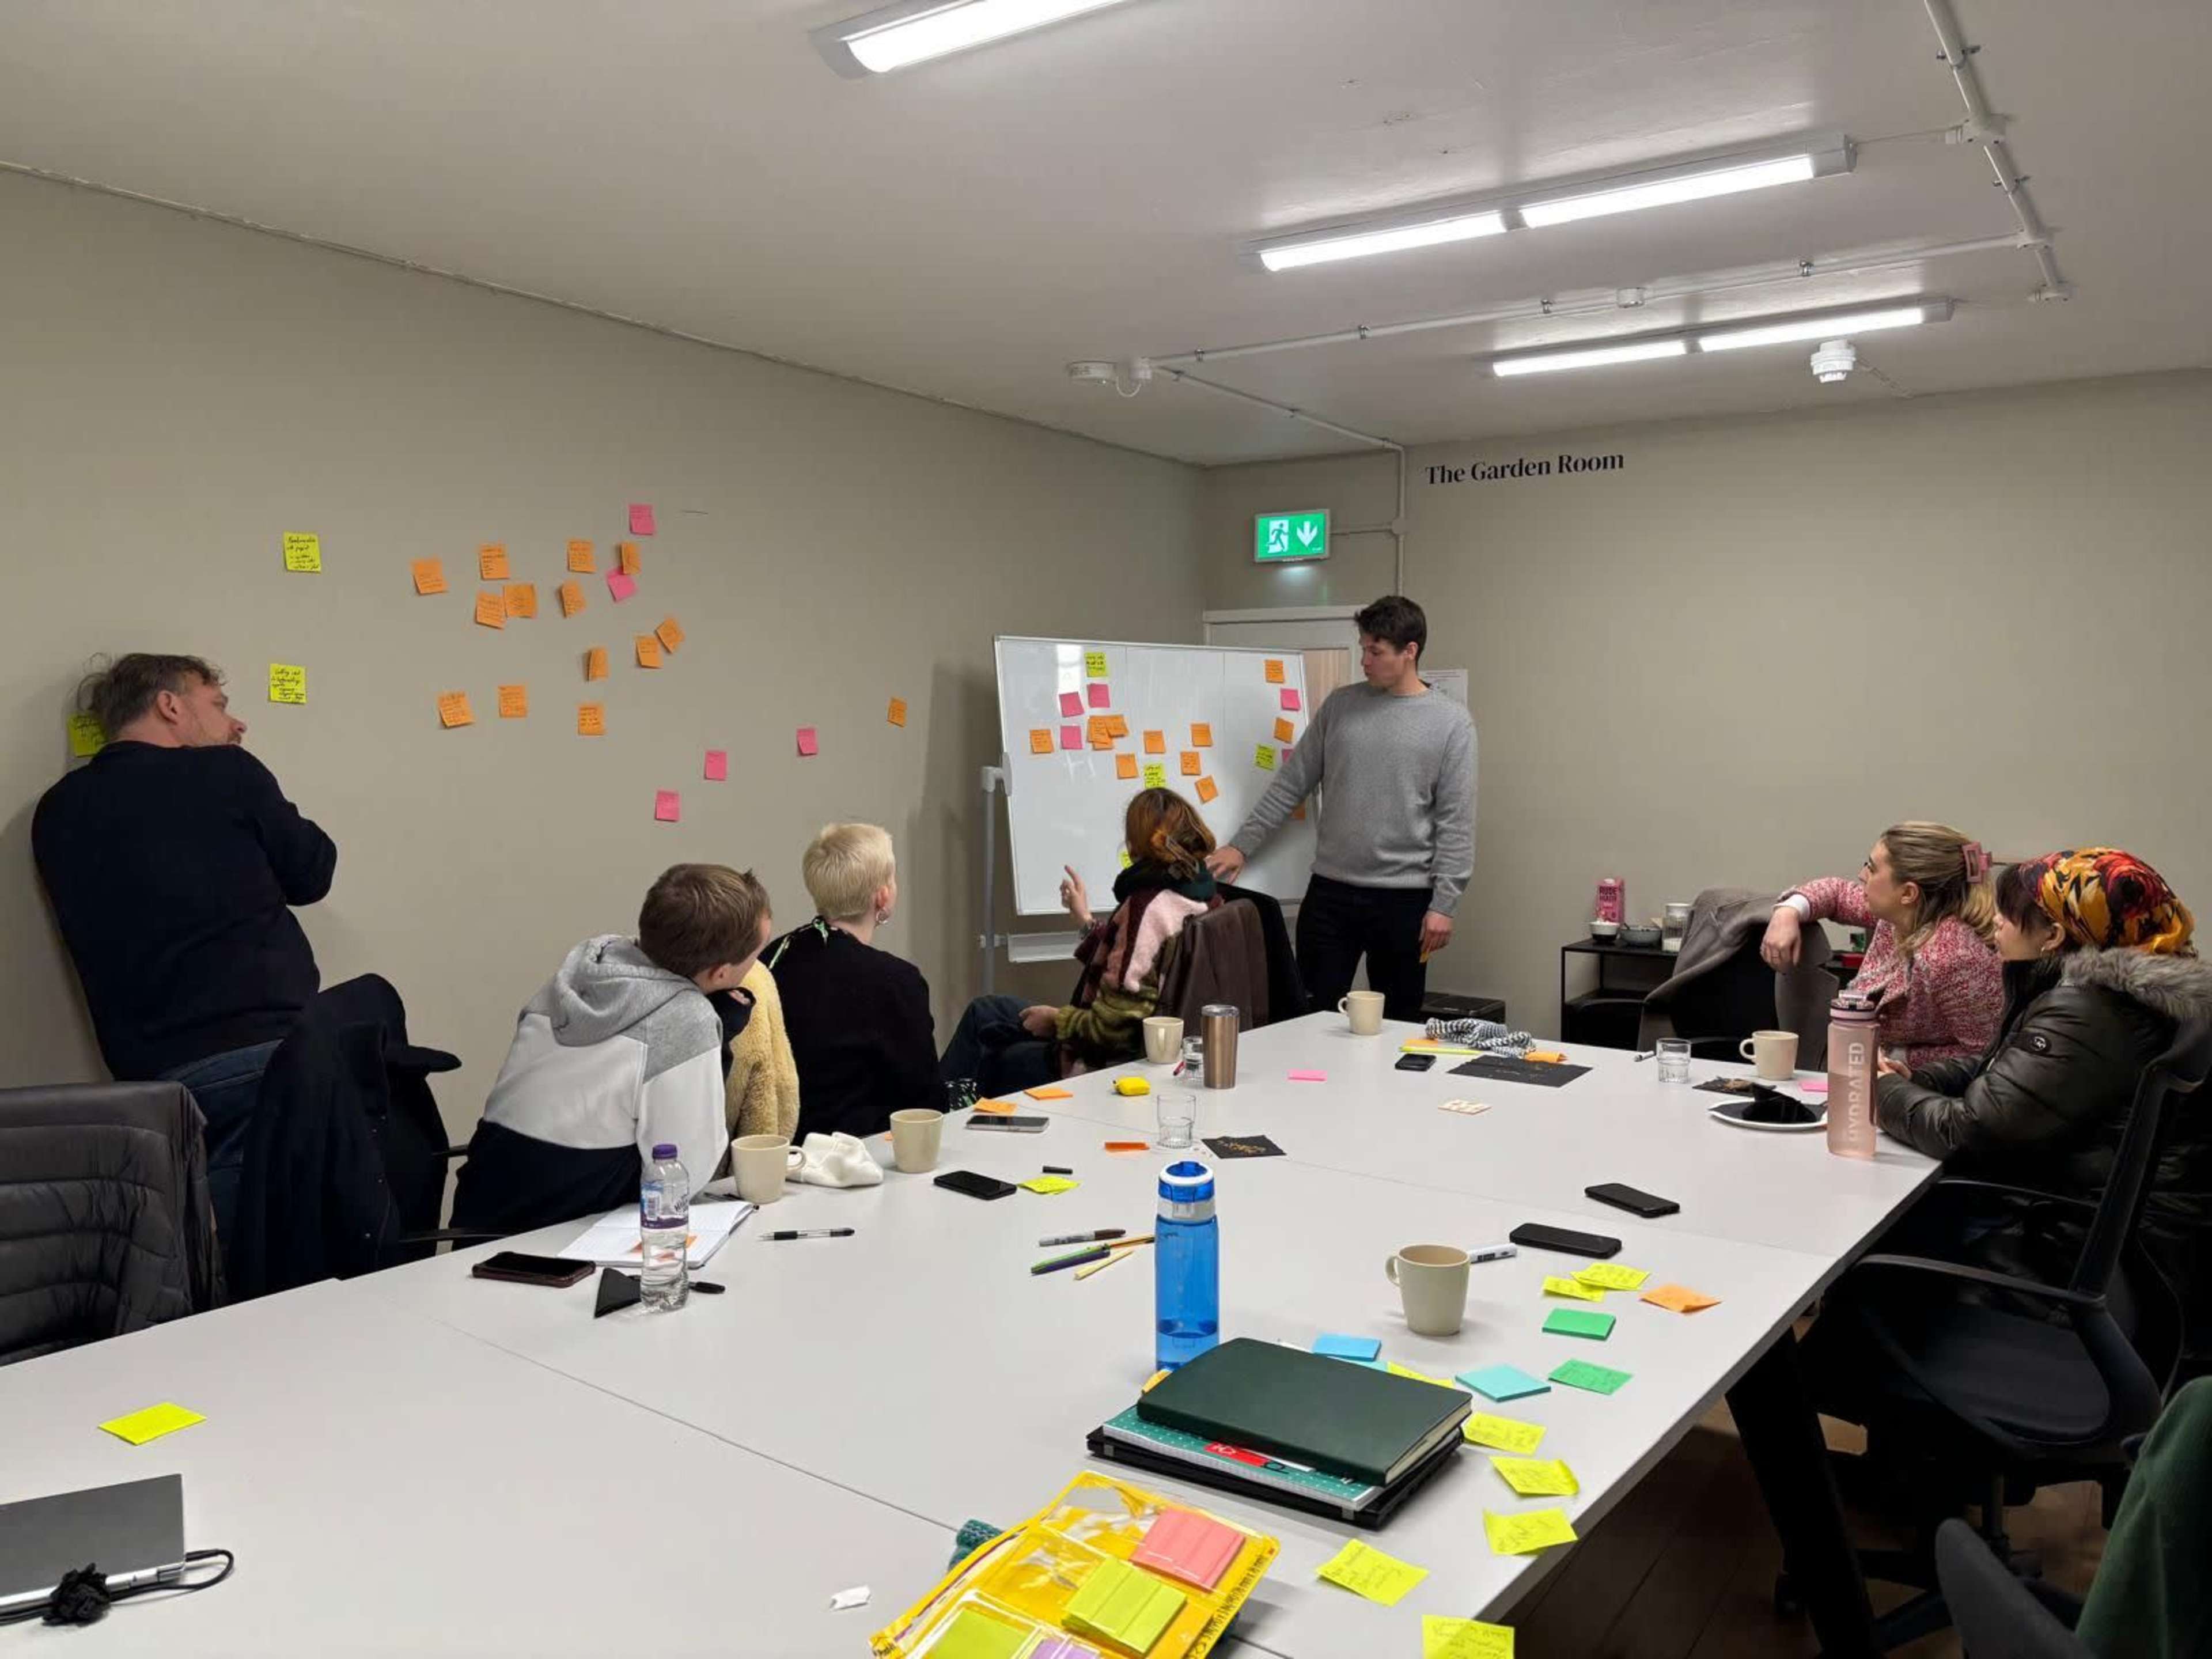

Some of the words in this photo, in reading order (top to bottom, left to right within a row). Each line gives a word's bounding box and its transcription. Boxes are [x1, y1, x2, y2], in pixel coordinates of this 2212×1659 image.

[1426, 465, 1465, 484] The
[1471, 458, 1551, 480] Garden
[1558, 453, 1624, 474] Room
[1848, 1041, 1865, 1142] HYDRATED
